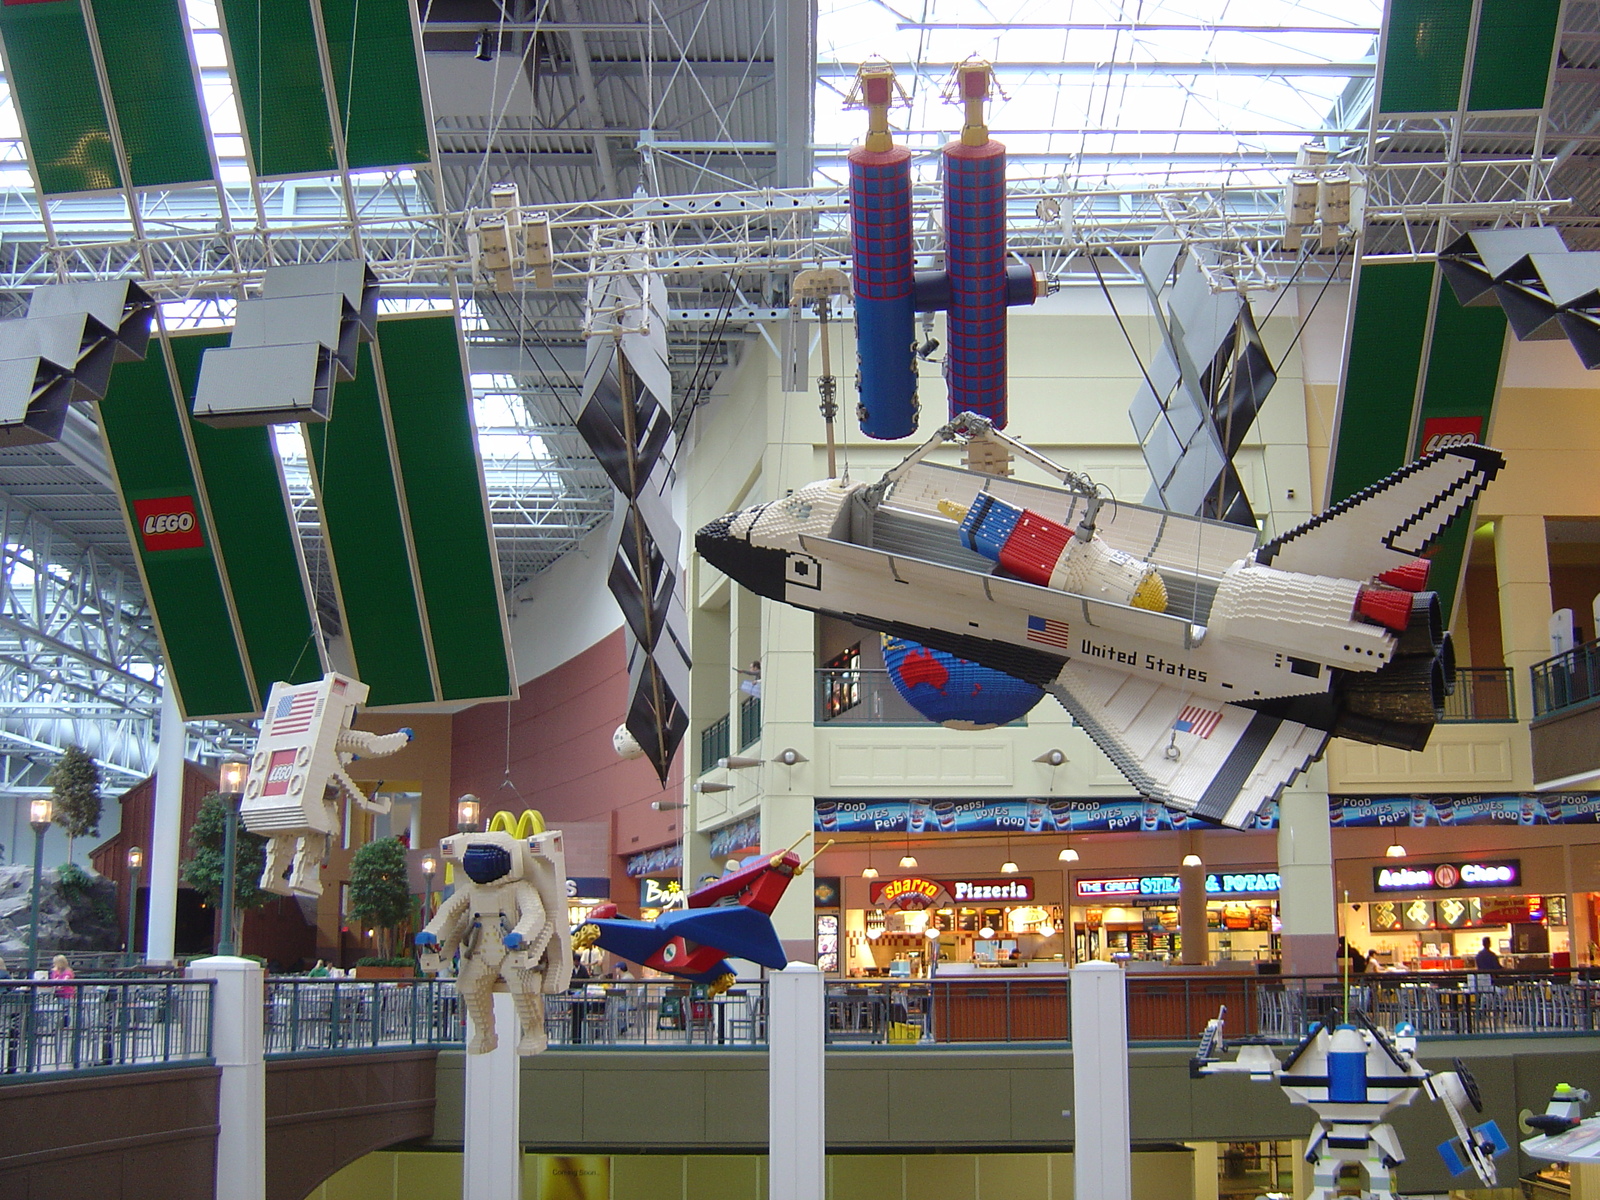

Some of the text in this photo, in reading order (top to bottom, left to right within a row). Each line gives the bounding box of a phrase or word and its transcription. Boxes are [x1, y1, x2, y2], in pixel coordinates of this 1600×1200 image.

[1424, 433, 1476, 452] LEGO
[144, 512, 194, 534] LEGO
[1081, 639, 1208, 683] United States
[269, 764, 294, 782] LEGO
[836, 802, 867, 812] FOOD
[1070, 801, 1100, 811] FOOD
[1343, 798, 1372, 807] FOOD
[1561, 795, 1588, 805] FOOD
[955, 800, 985, 815] Pepsi
[974, 806, 1010, 820] LOVES
[1087, 807, 1122, 821] LOVES
[1358, 803, 1392, 817] LOVES
[1470, 801, 1503, 815] LOVES
[1575, 803, 1600, 814] LOVE
[853, 808, 889, 822] LOVES
[874, 812, 907, 830] Pepsi
[996, 817, 1025, 826] FOOD
[1108, 811, 1140, 830] Pepsi
[1378, 808, 1409, 825] Pepsi
[1491, 811, 1518, 820] FOOD
[1081, 883, 1101, 892] THE
[1105, 881, 1139, 891] GREAT
[1140, 877, 1180, 894] STEA
[1205, 874, 1220, 891] &
[1378, 868, 1432, 887] Asian
[885, 879, 938, 899] sbarro
[954, 881, 1027, 899] Pizzeria
